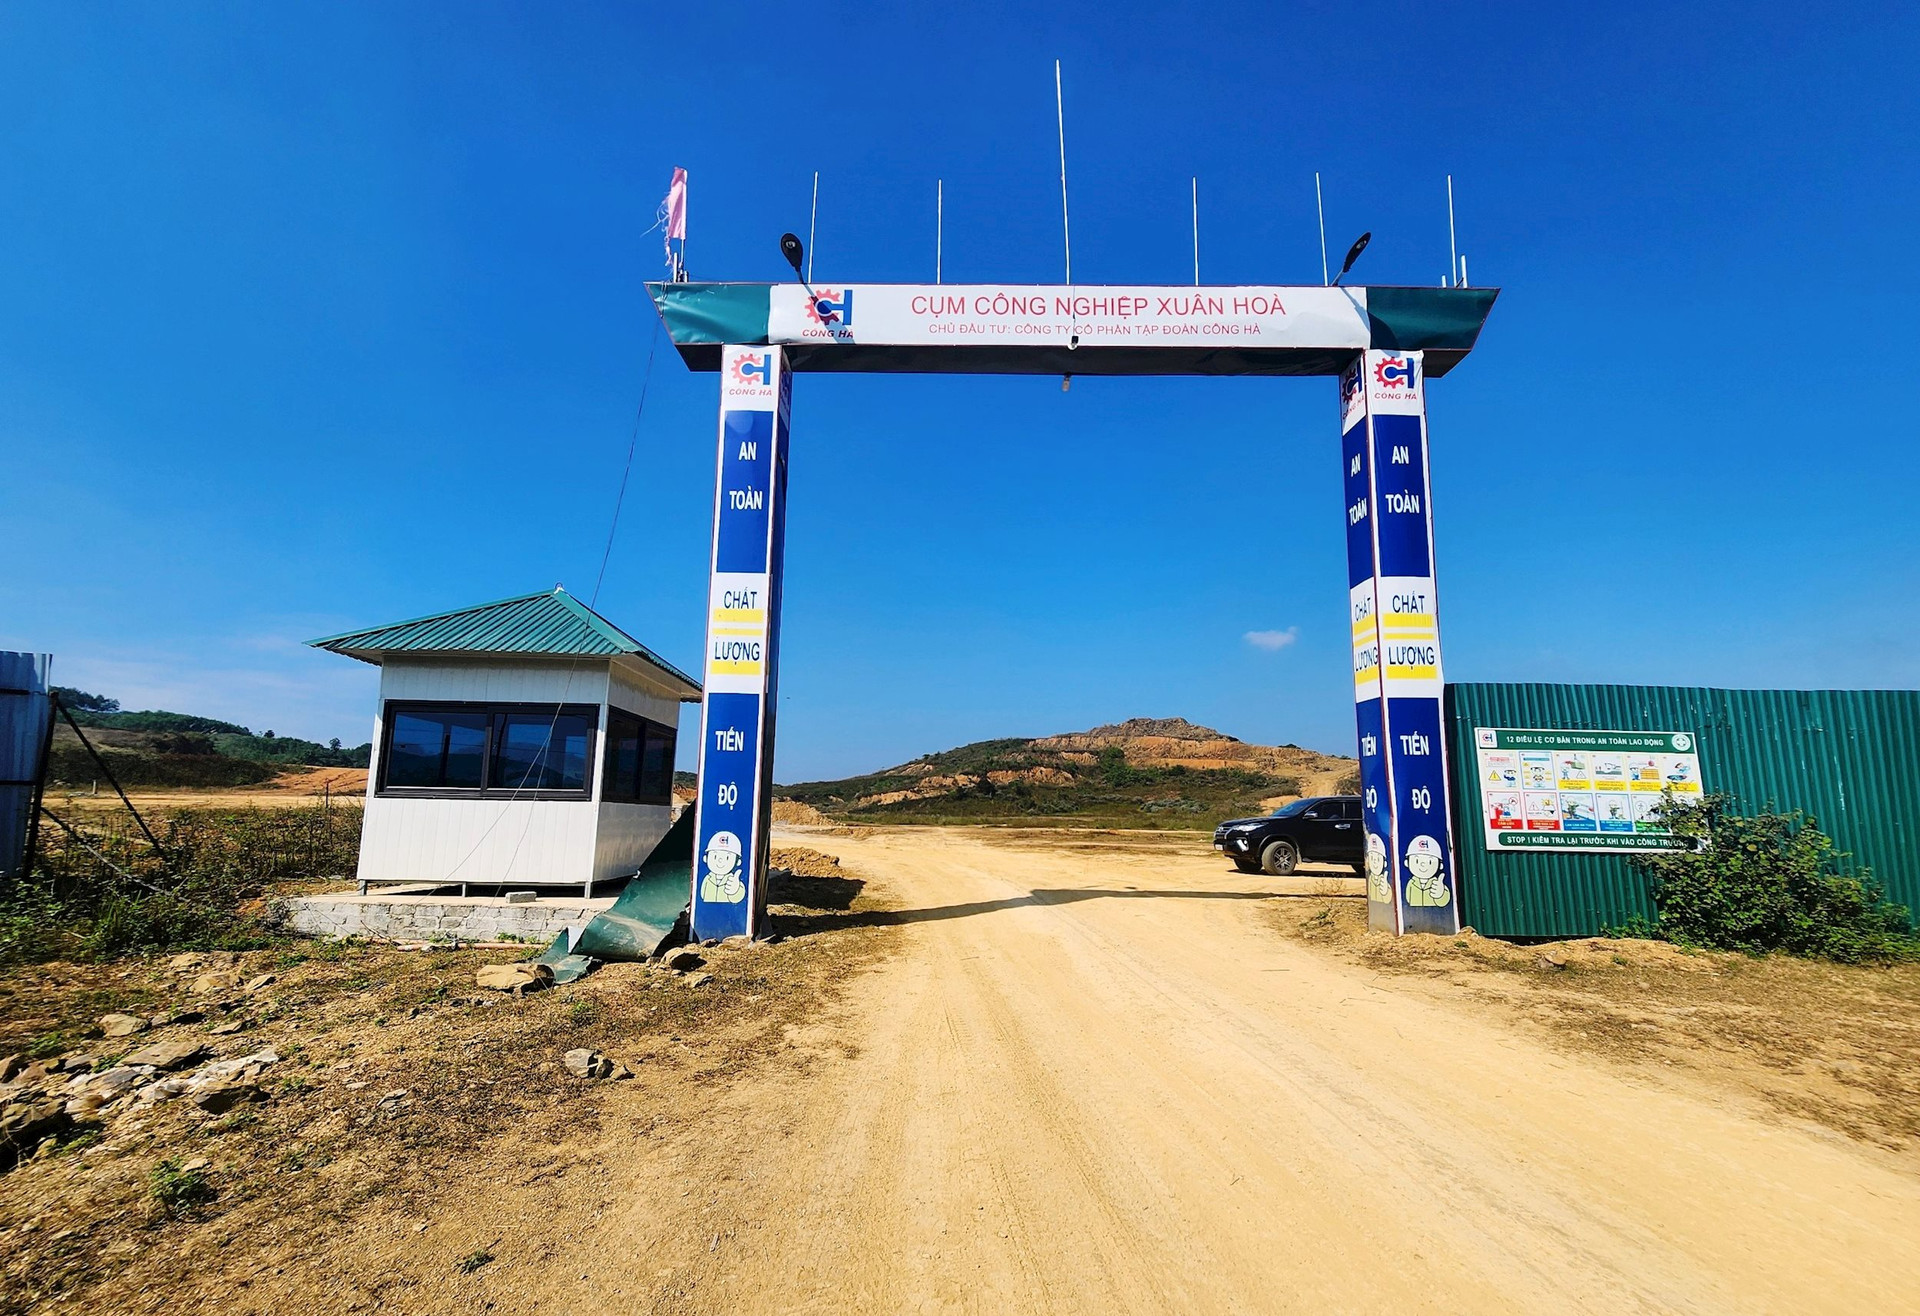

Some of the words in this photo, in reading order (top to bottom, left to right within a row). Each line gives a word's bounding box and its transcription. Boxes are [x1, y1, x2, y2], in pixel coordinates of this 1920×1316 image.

[911, 296, 965, 318] CỤM
[975, 292, 1046, 316] CÔNG
[1055, 296, 1148, 319] NGHIỆP
[1156, 294, 1223, 315] XUÂN
[1234, 293, 1286, 315] HOÀ
[929, 322, 955, 334] CHỦ
[989, 324, 1011, 334] TƯ:
[1014, 323, 1052, 335] CÔNG
[1055, 325, 1071, 334] TY
[1163, 323, 1199, 335] ĐOÀN
[1202, 323, 1240, 335] CÔNG
[1244, 322, 1261, 335] HÀ
[739, 442, 757, 460] AN
[1392, 445, 1409, 464] AN
[1351, 453, 1361, 477] AN
[729, 486, 763, 510] TOÀN
[1385, 489, 1420, 514] TOÀN
[1349, 498, 1368, 526] TOÀN
[723, 587, 757, 609] CHẤT
[1392, 591, 1425, 614] CHẤT
[715, 642, 760, 665] LƯỢNG
[1388, 646, 1435, 670] LƯỢNG
[715, 726, 744, 752] TIẾN
[1400, 730, 1430, 756] TIẾN
[1608, 737, 1627, 745] TOÀN
[1629, 738, 1642, 746] LAO
[717, 781, 738, 811] ĐỘ
[1412, 785, 1431, 815] ĐỘ
[1507, 836, 1526, 844] STOP
[1552, 836, 1566, 844] TRA
[1566, 837, 1578, 845] LẠI
[1606, 837, 1619, 845] KHI
[1620, 837, 1635, 846] VÀO
[1636, 837, 1657, 846] CÔNG
